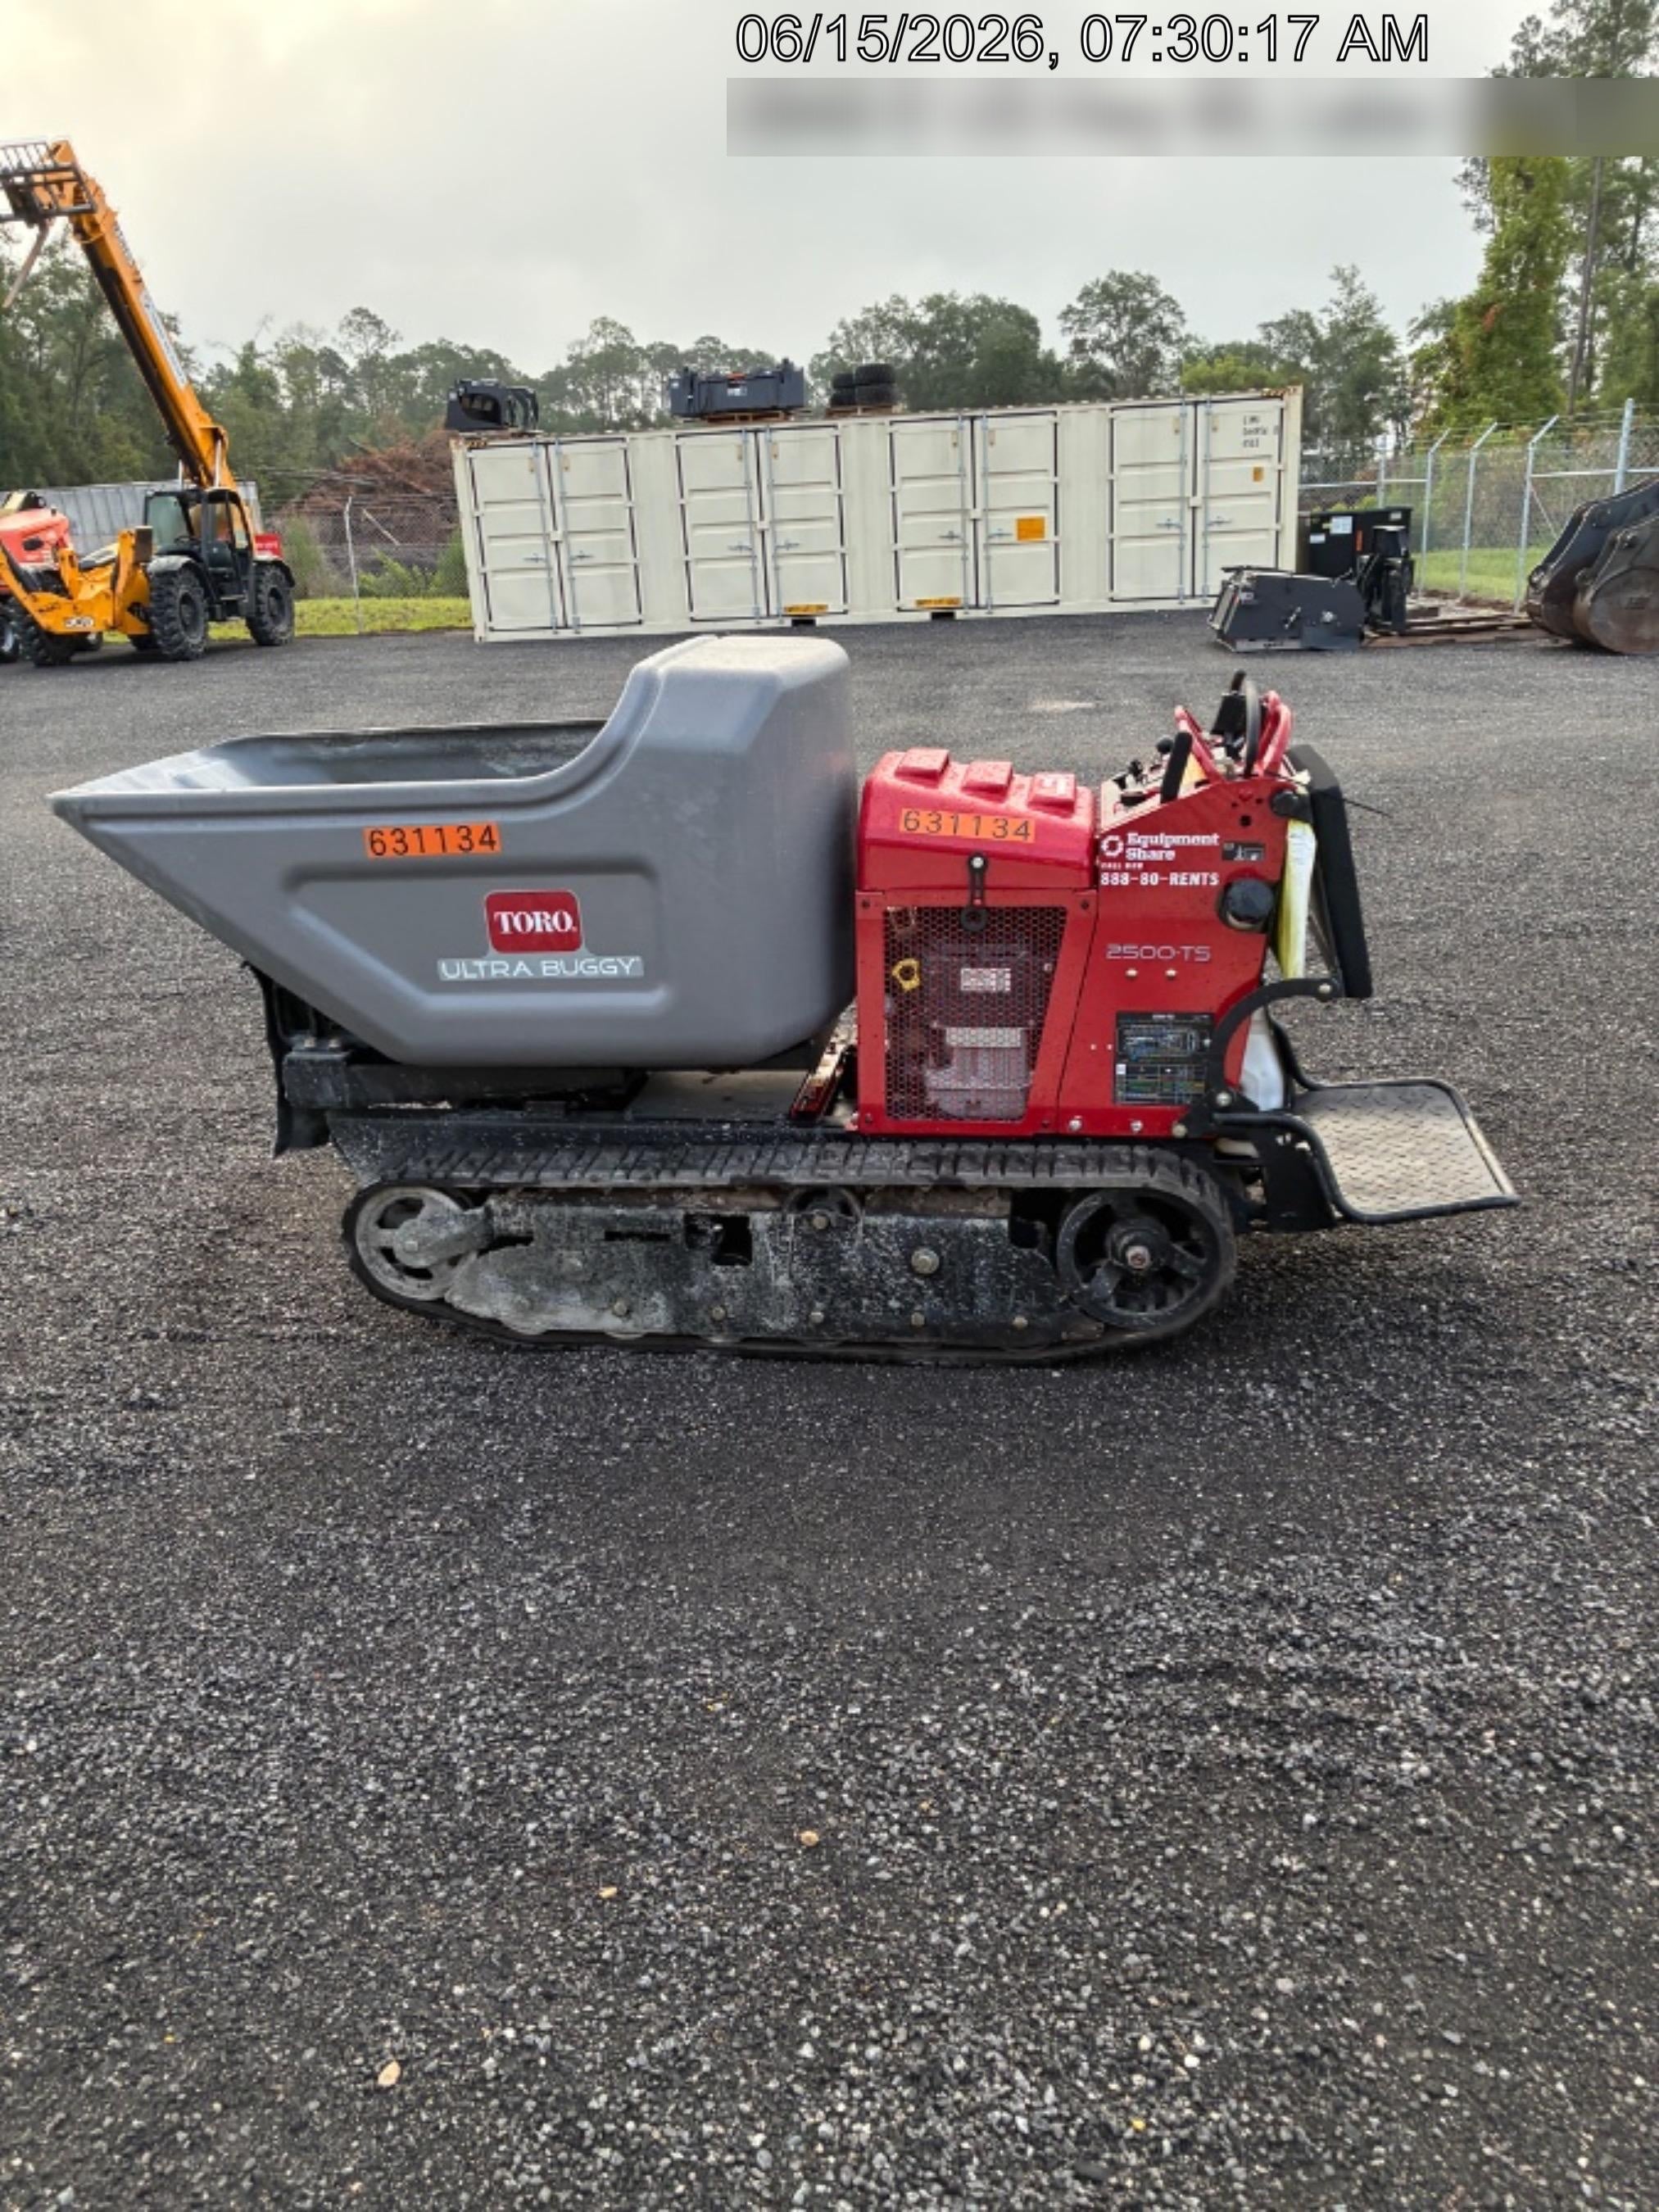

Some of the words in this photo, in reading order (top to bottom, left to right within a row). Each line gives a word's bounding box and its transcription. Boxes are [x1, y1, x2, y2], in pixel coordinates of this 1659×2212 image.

[904, 811, 1030, 841] 631134
[369, 825, 496, 856] 631134
[1126, 832, 1220, 848] Equipment
[1126, 848, 1176, 860] Share
[1100, 872, 1220, 886] 888-80-RENTS
[493, 910, 573, 935] TORO
[441, 959, 533, 979] ULTRA
[540, 957, 635, 977] BUGGY
